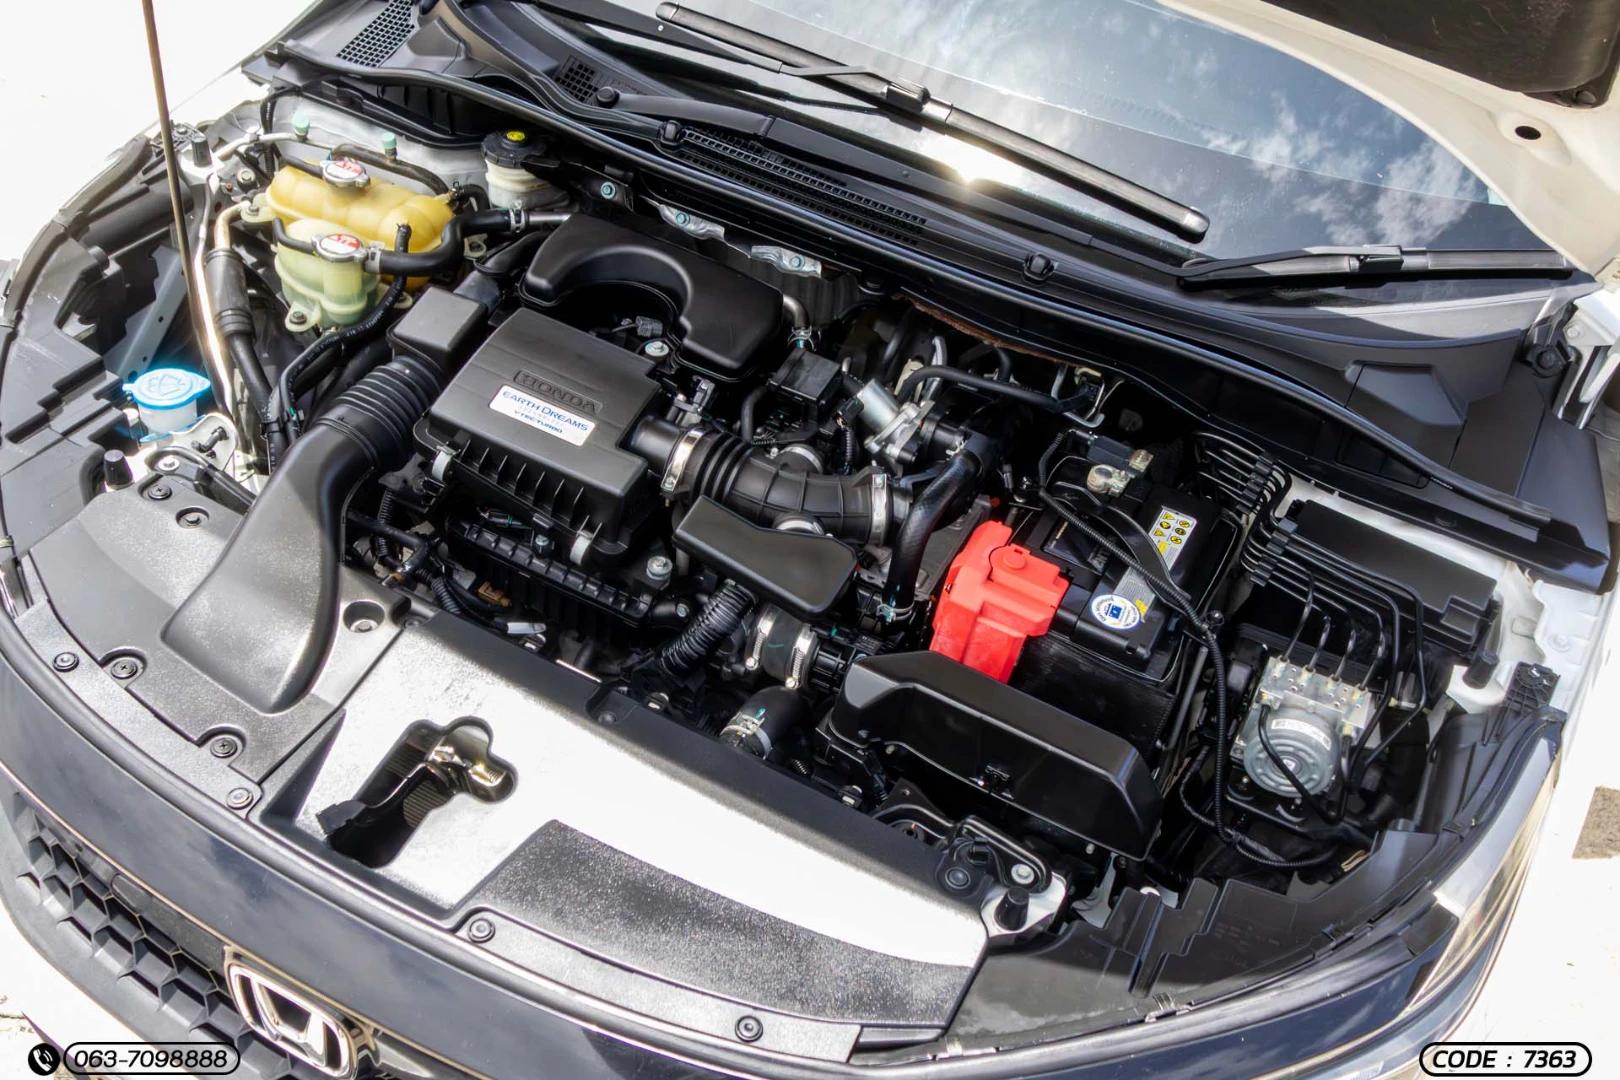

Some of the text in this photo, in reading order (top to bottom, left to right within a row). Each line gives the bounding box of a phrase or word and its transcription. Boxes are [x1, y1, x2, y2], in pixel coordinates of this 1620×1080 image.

[503, 390, 541, 411] EARTH
[541, 406, 589, 432] DREAMS
[536, 420, 563, 434] TURBO
